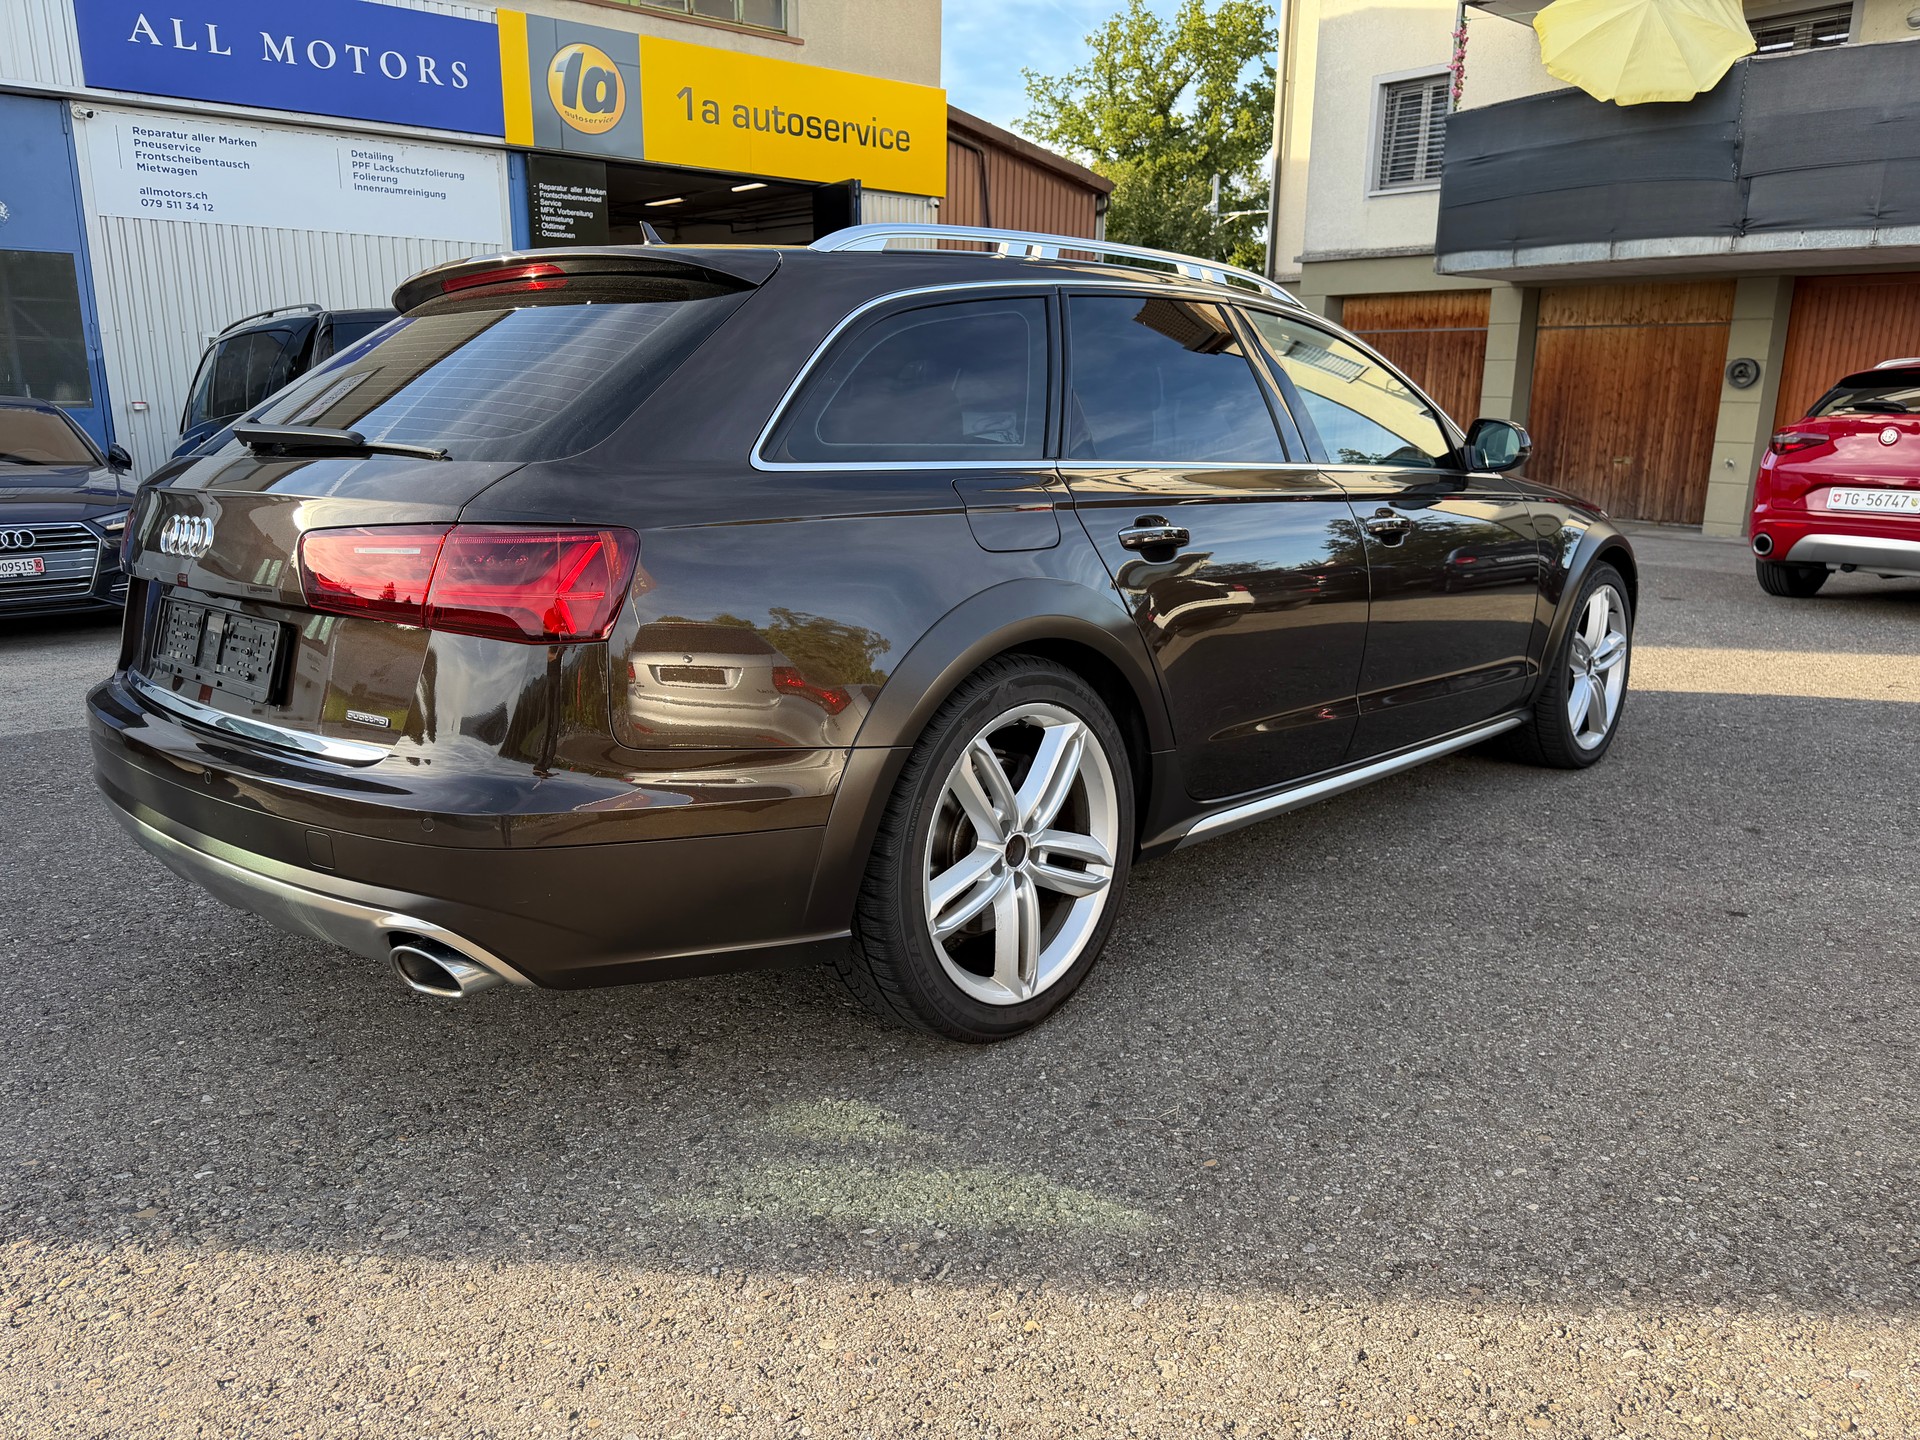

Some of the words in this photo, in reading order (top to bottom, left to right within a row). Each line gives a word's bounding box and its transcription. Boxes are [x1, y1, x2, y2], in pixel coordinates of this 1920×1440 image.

[128, 13, 232, 56] ALL
[259, 31, 469, 89] MOTORS
[555, 52, 618, 114] 1a
[564, 110, 614, 124] autoservice
[675, 86, 720, 126] 1a
[732, 103, 911, 152] autoservice
[132, 126, 188, 141] Reparatur
[191, 133, 216, 143] aller
[218, 135, 258, 148] Marken
[133, 138, 202, 153] Pneuservice
[135, 150, 250, 170] Frontscheibentausch
[351, 149, 394, 163] Detailing
[136, 162, 198, 177] Mietwagen
[352, 161, 371, 170] PPF
[373, 162, 465, 181] Lackschutzfolierung
[353, 172, 398, 185] Folierung
[139, 186, 208, 200] allmotors.ch
[354, 182, 447, 200] Innenraumreinigung
[538, 182, 568, 192] Reparatur
[585, 187, 607, 196] Marken
[539, 190, 602, 203] Frontscheibenwechsel
[540, 198, 562, 207] Service
[140, 198, 163, 208] 079
[166, 200, 182, 209] 511
[185, 201, 200, 211] 34
[203, 203, 214, 212] 12
[540, 206, 555, 214] MFK
[556, 208, 594, 219] Vorbereitung
[540, 214, 574, 225] Vermietung
[541, 222, 566, 230] Oldtimer
[541, 230, 576, 239] Occasionen
[0, 561, 34, 572] 09515
[347, 712, 386, 725] quattro
